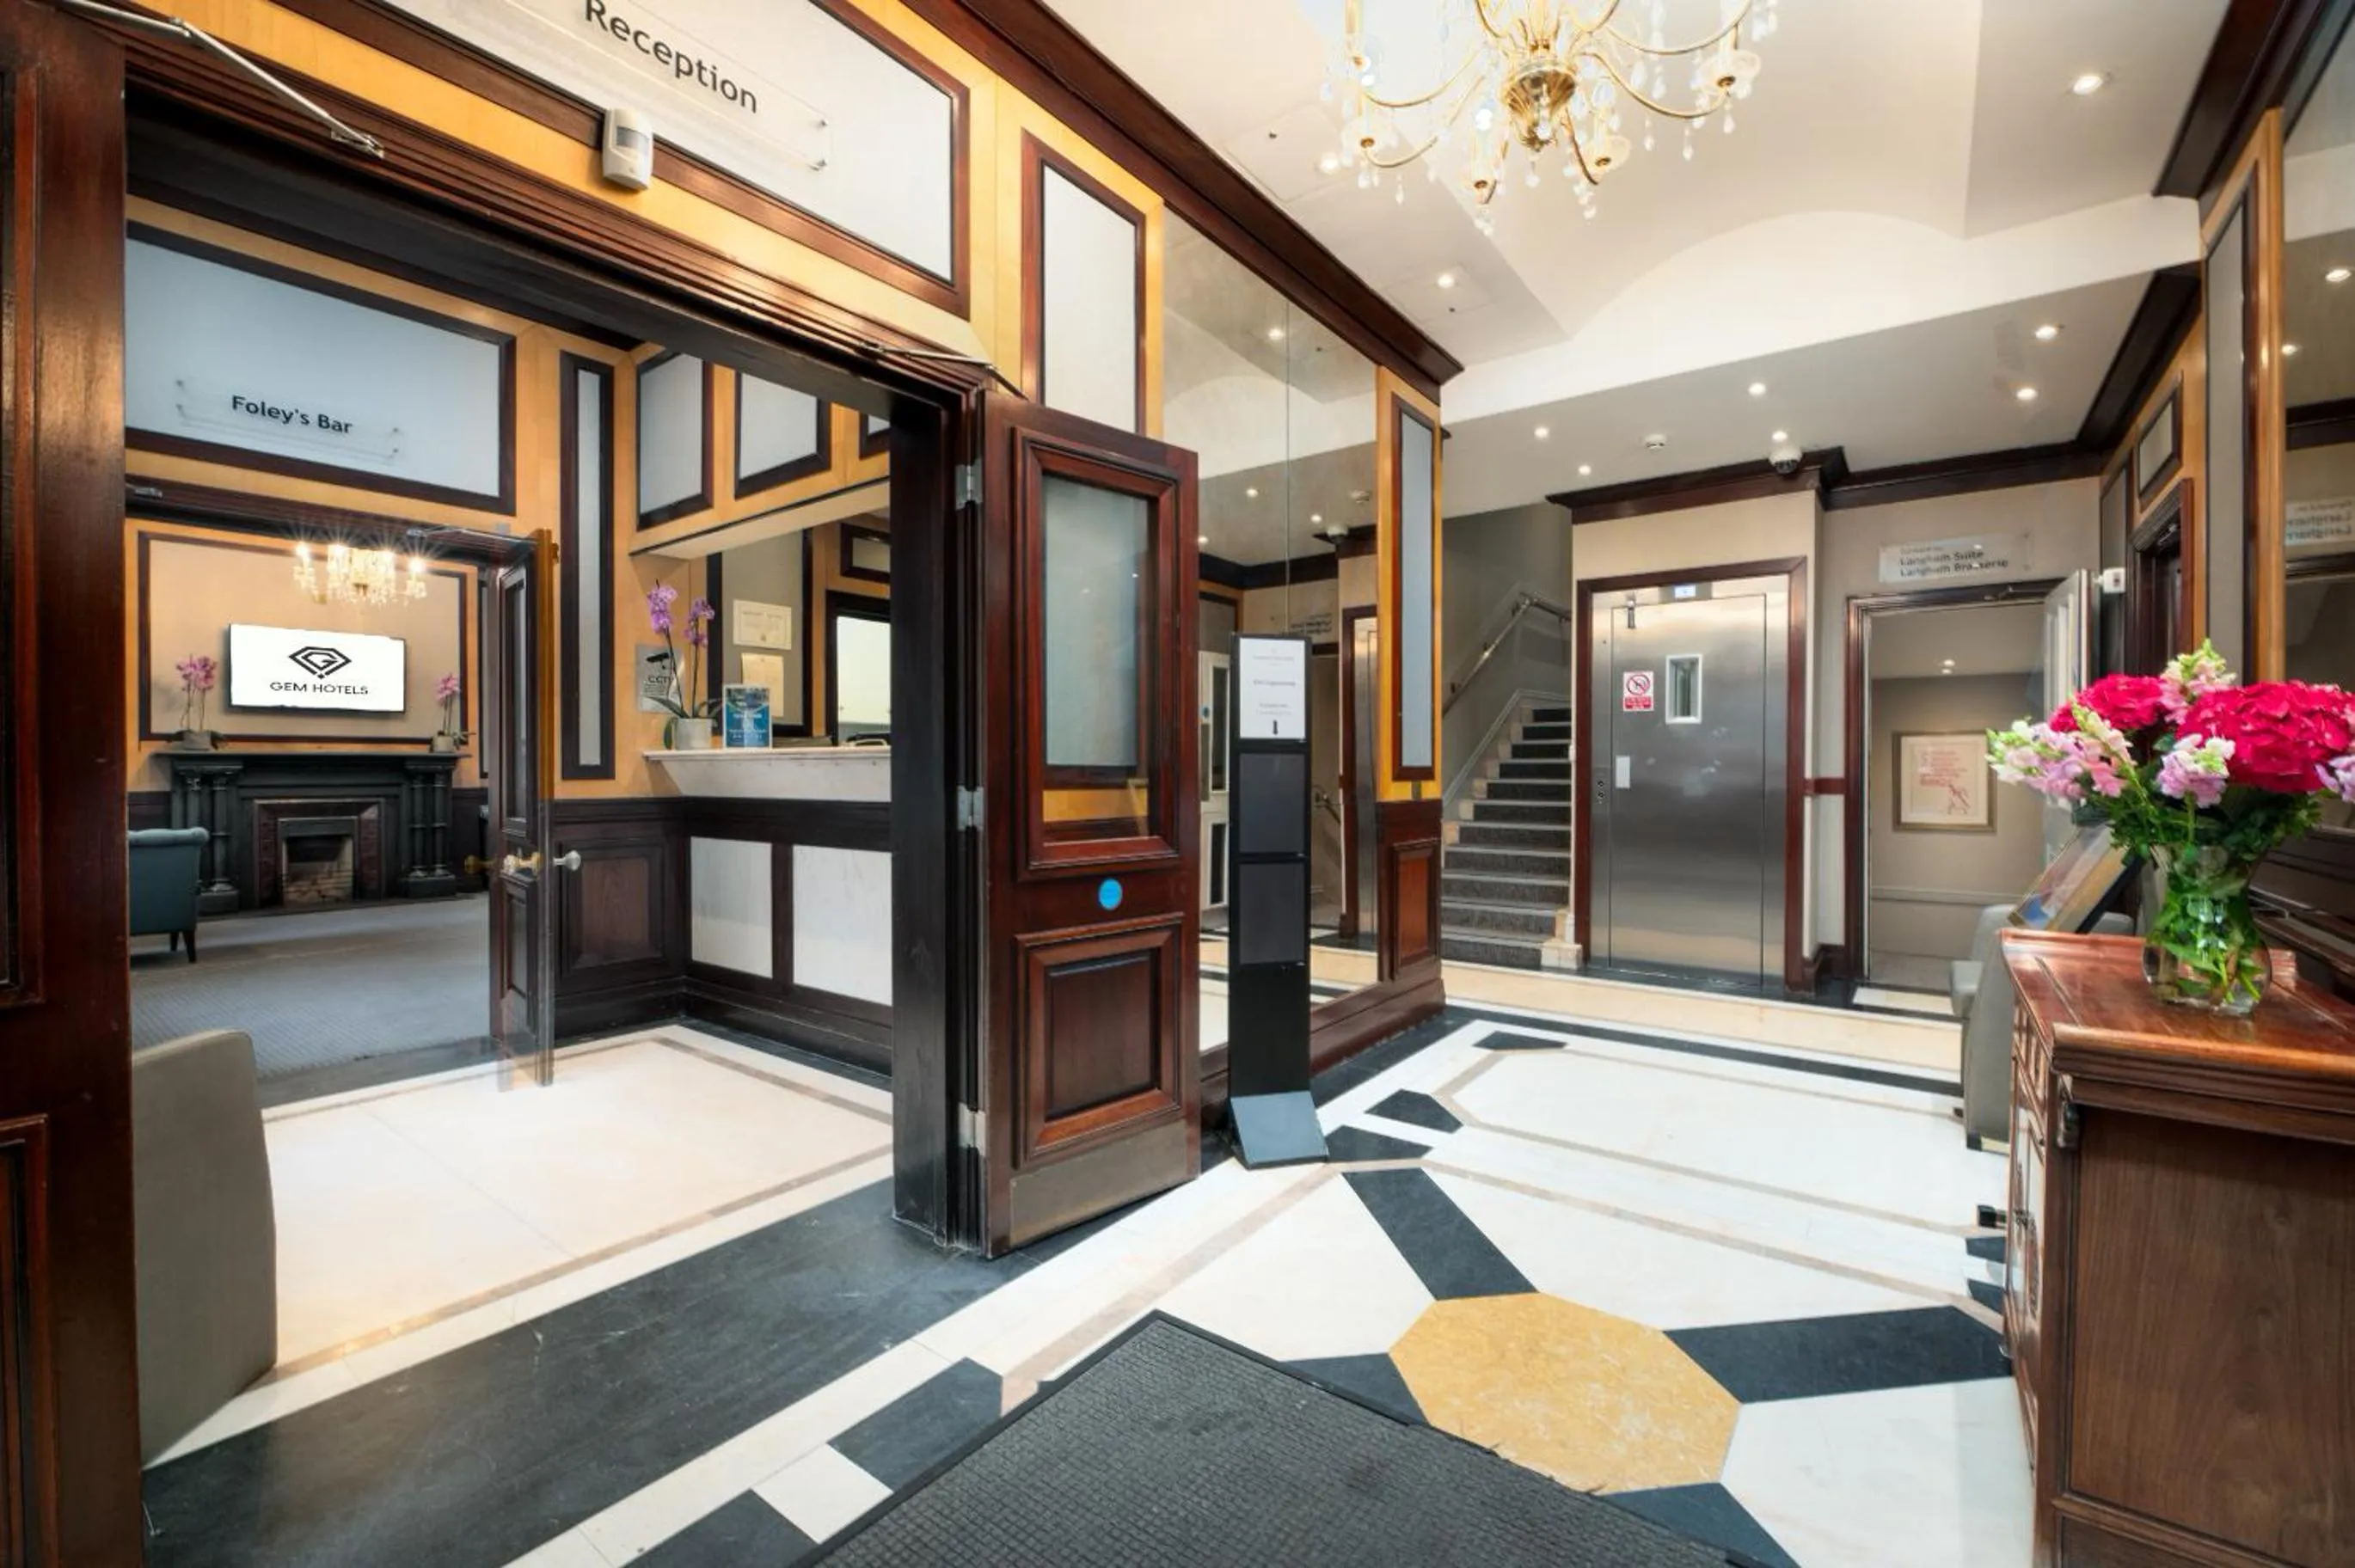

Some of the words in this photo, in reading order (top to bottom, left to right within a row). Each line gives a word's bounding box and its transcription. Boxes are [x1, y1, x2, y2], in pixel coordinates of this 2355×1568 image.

[586, 0, 757, 113] Reception
[232, 395, 310, 425] Foley's
[317, 413, 353, 433] Bar
[1953, 550, 1984, 560] Suite
[269, 682, 307, 692] GEM
[312, 683, 368, 695] HOTELS
